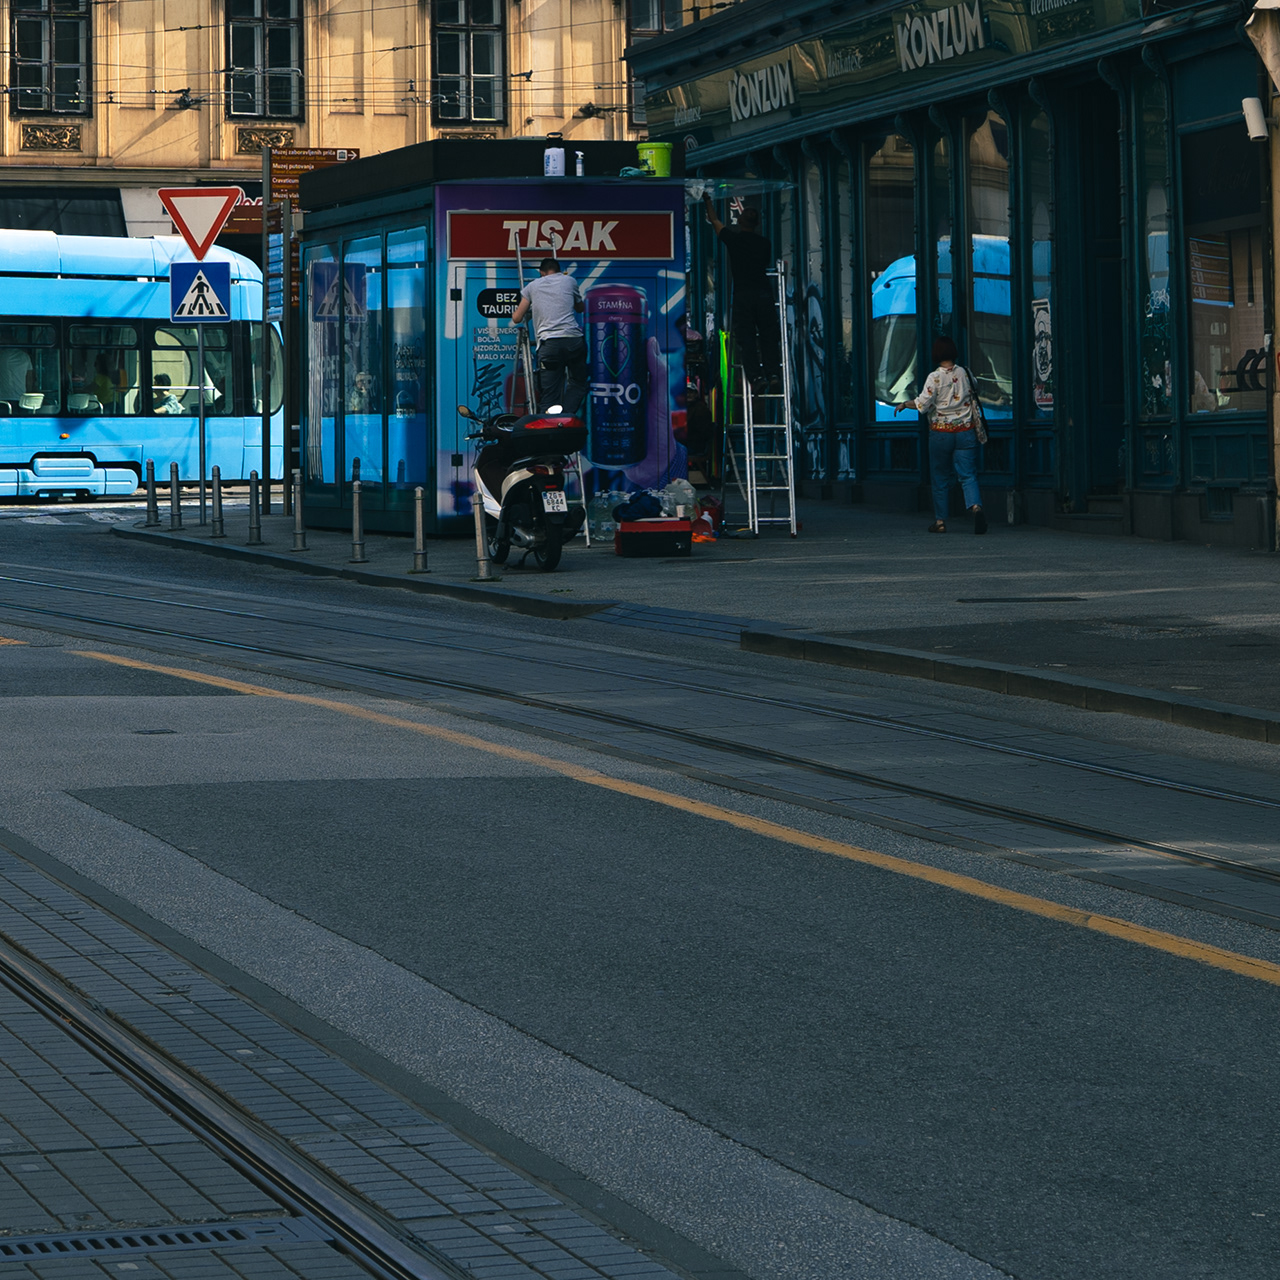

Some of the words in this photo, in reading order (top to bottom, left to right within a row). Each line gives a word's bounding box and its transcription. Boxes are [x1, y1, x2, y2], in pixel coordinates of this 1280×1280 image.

[728, 59, 795, 122] KONZUM
[272, 149, 288, 157] Muzej
[503, 219, 619, 251] TISAK
[496, 293, 517, 303] BEZ
